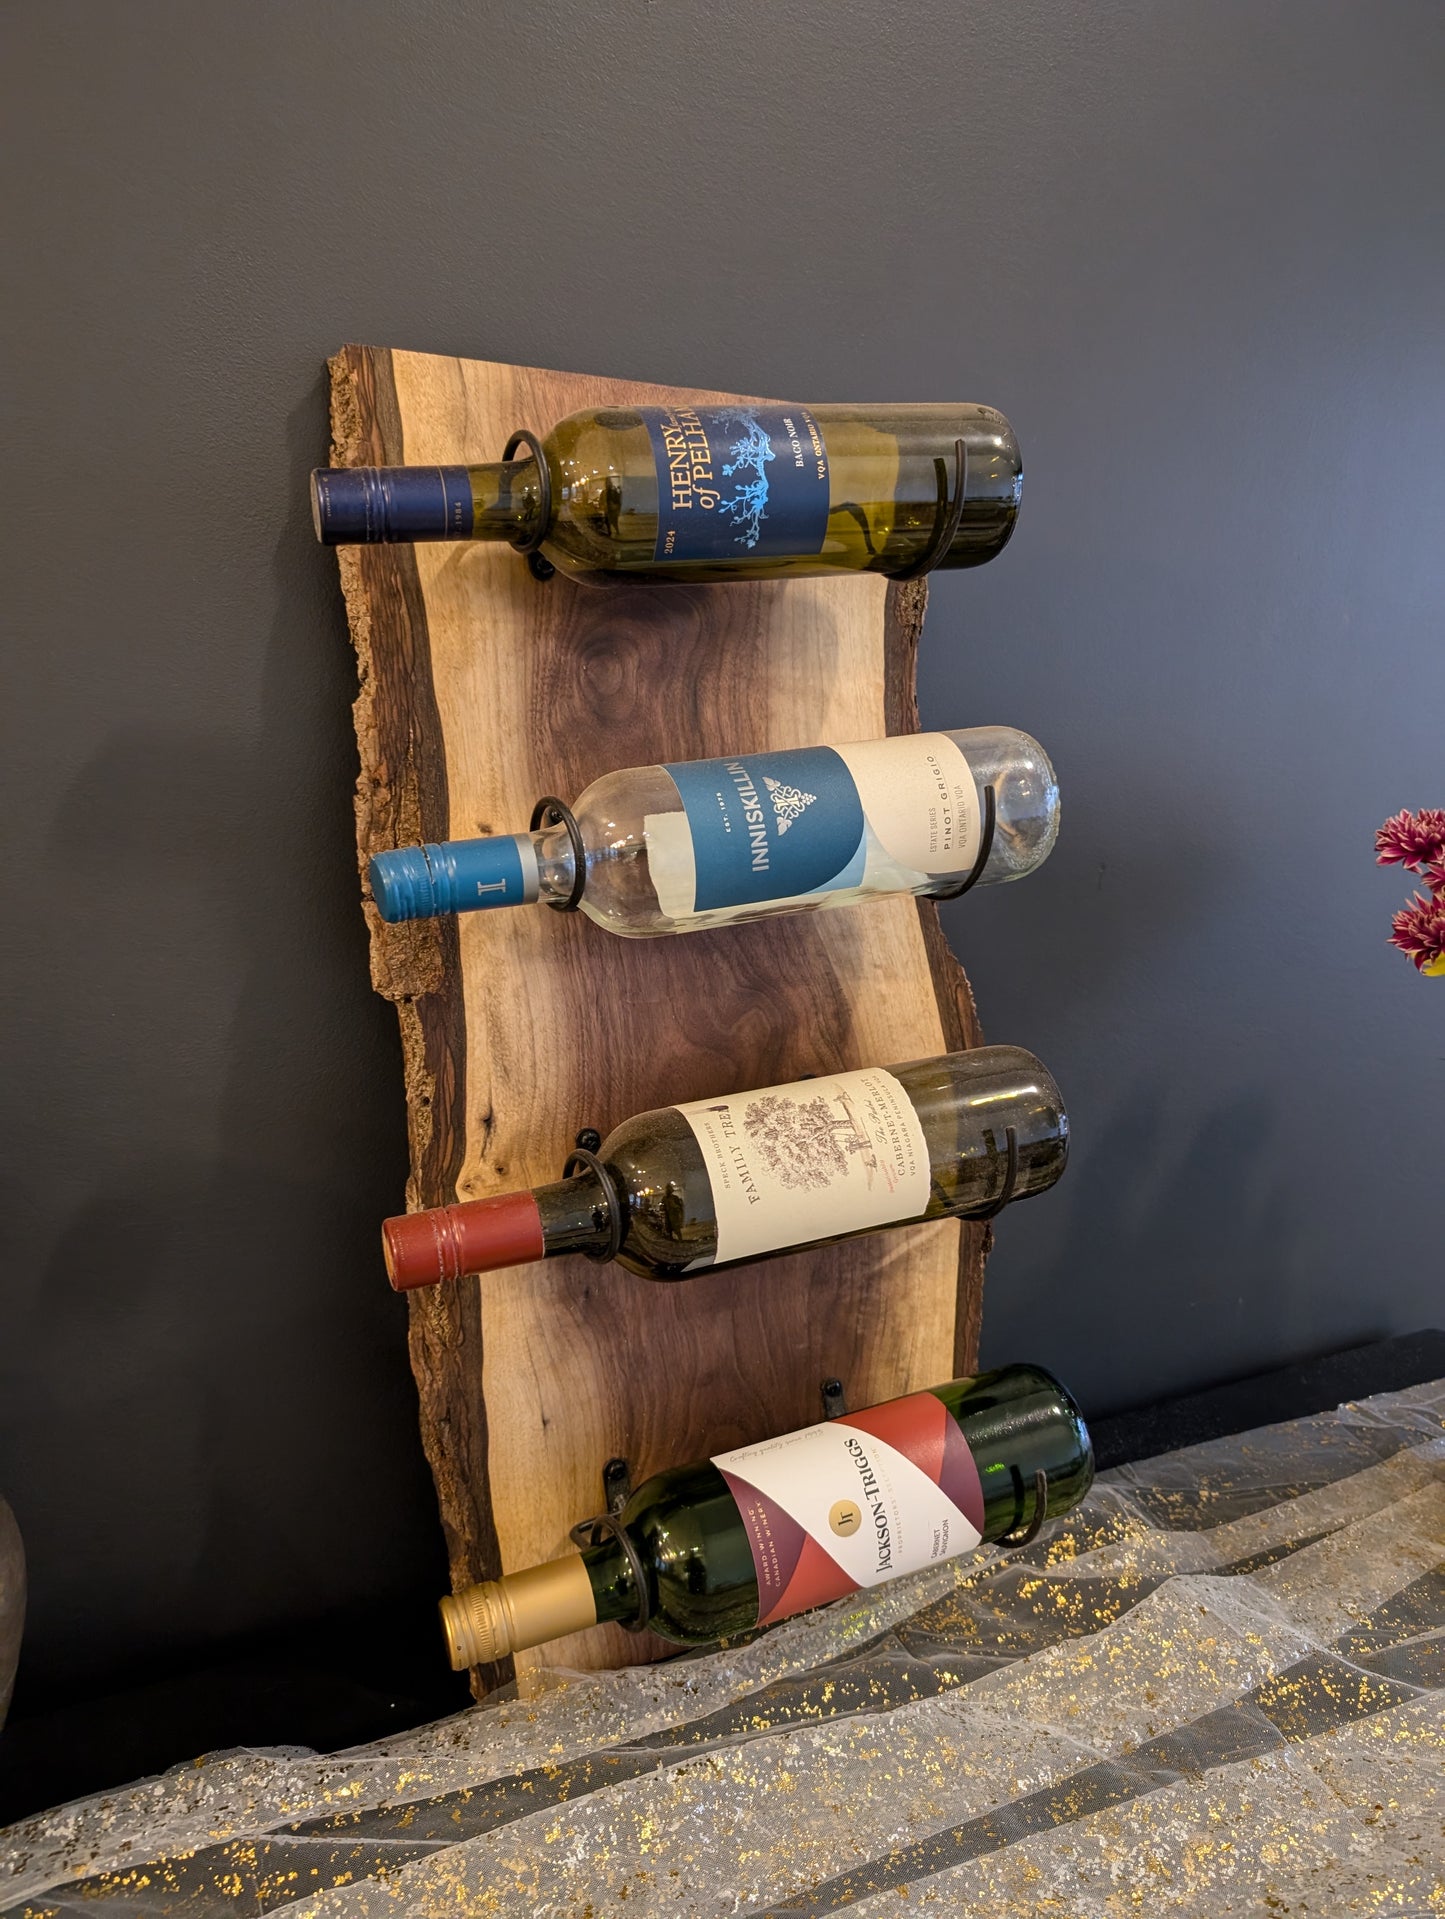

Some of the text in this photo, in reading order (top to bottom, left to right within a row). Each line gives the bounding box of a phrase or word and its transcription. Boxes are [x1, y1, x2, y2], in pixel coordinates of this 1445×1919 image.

[783, 417, 804, 467] BACO NOIR
[807, 423, 823, 458] ONTARIO
[660, 422, 693, 510] HENRY
[817, 459, 826, 480] VQA
[692, 484, 721, 510] of
[664, 530, 676, 554] 2024
[723, 762, 770, 872] INNISKILLIN
[926, 756, 952, 850] PINOT GRIGIO
[957, 801, 967, 834] ONTARIO
[928, 807, 938, 853] ESTATE SERIES
[860, 1078, 906, 1176] CABERNET-MERLOT
[900, 1122, 914, 1158] NIAGARA
[720, 1162, 731, 1189] SPECK
[728, 1145, 760, 1205] FAMILY
[907, 1160, 916, 1177] VQA
[844, 1438, 893, 1573] JACKSON-TRIGGS
[749, 1509, 771, 1586] AWARD-WINNING
[756, 1502, 781, 1587] CANADIAN WINERY
